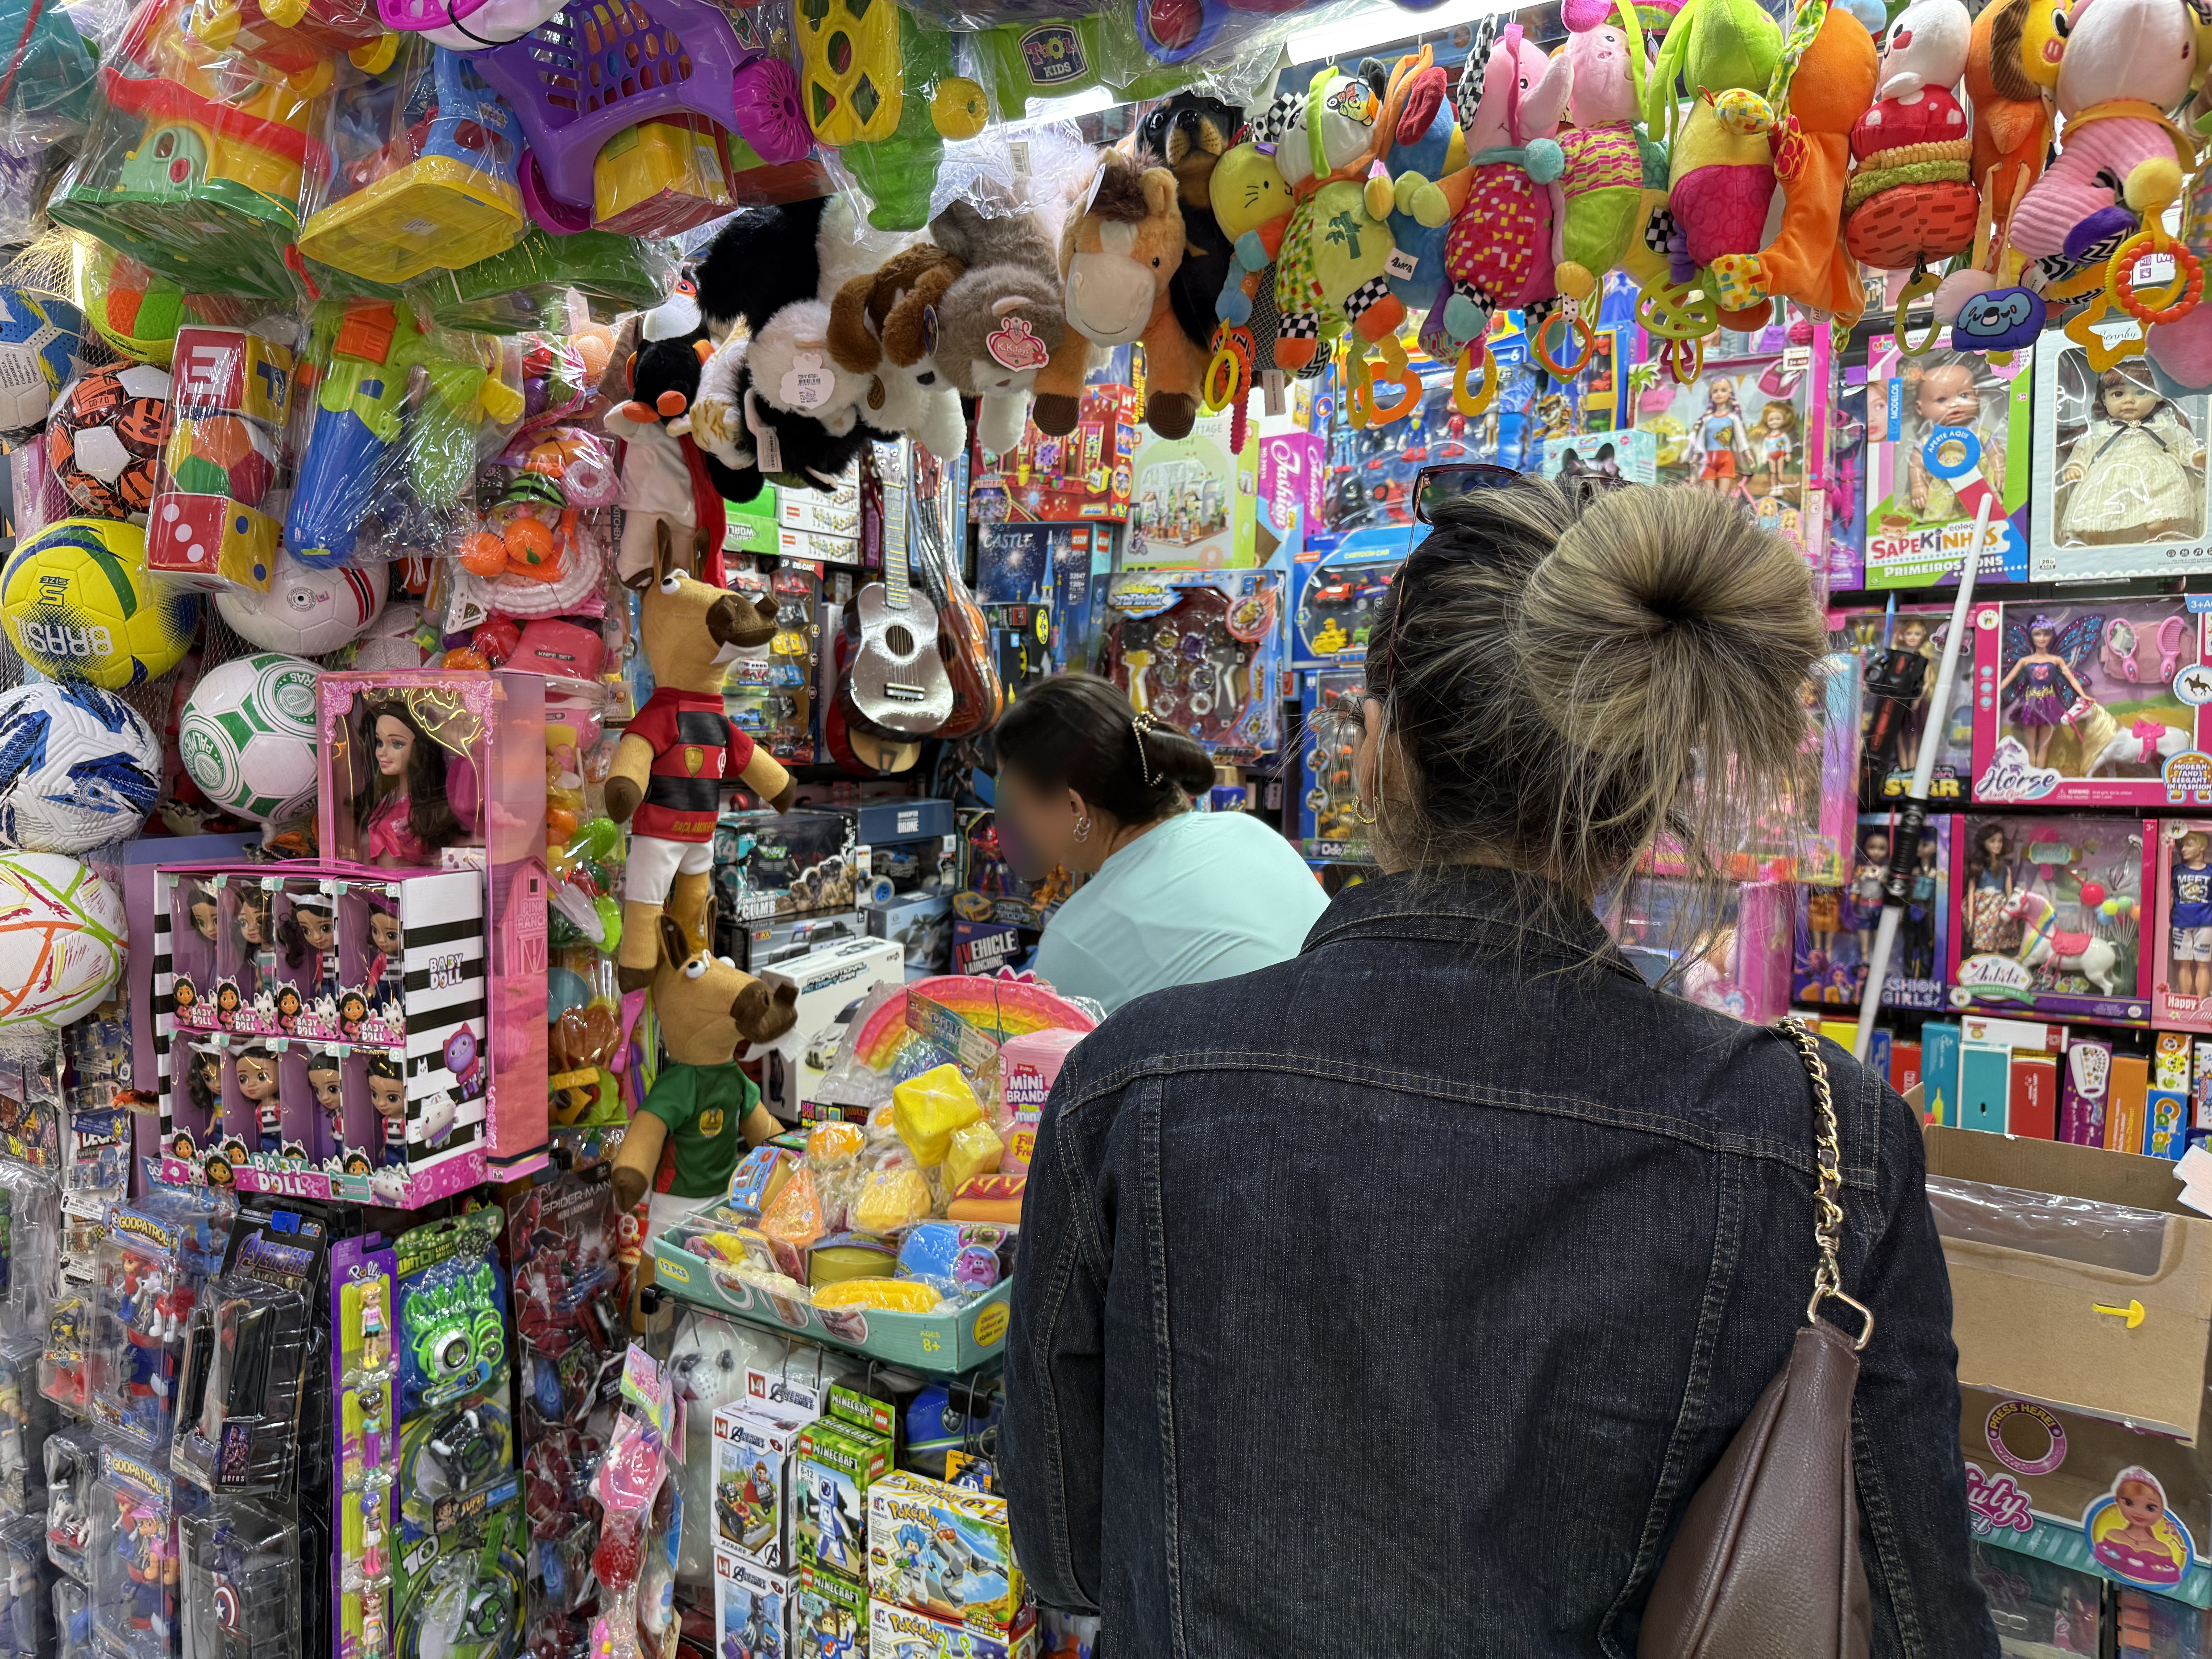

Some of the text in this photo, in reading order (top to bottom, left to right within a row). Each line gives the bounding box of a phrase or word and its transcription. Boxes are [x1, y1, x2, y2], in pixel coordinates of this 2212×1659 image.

[1024, 37, 1076, 66] TOOL
[1043, 62, 1072, 77] KIDS
[1511, 349, 1519, 361] 6
[17, 369, 26, 384] Ciudad
[1890, 384, 1899, 420] MODELOS
[1192, 424, 1223, 434] OTTAGE
[1927, 431, 1948, 453] APERTE
[1270, 440, 1302, 531] Fashion
[1306, 444, 1324, 518] Fashion
[613, 505, 622, 541] KITCHEN
[728, 524, 754, 538] WORL
[1949, 522, 1976, 532] coleç
[983, 533, 1034, 549] CASTLE
[1884, 559, 1961, 578] PRIMEIROS
[41, 576, 69, 586] SIZE
[39, 585, 68, 607] 5
[11, 614, 114, 656] BRASIL
[2173, 763, 2208, 771] MODERN
[1976, 768, 2056, 795] Horse
[897, 821, 919, 834] DRONE
[2177, 874, 2210, 885] MEET
[522, 898, 545, 915] PINK
[956, 930, 1018, 963] VEHICLE
[429, 953, 464, 973] BABY
[963, 955, 1004, 975] LAUNCHING
[430, 968, 464, 990] DOLL
[807, 962, 867, 984] PROPORTIONAL
[839, 972, 857, 984] CAR
[1881, 990, 1934, 1007] GIRLS
[2167, 994, 2197, 1011] Happy
[192, 1007, 211, 1017] BABY
[192, 1015, 213, 1026] DOLL
[235, 1012, 256, 1022] BABY
[297, 1017, 318, 1026] BABY
[235, 1020, 256, 1031] DOLL
[297, 1025, 318, 1037] DOLL
[361, 1022, 385, 1032] BABY
[362, 1031, 385, 1042] DOLL
[254, 1155, 302, 1175] BABY
[258, 1172, 306, 1195] DOLL
[542, 1178, 612, 1216] SPIDER-MAN
[557, 1198, 594, 1221] HERO LAUNCHER
[118, 1214, 169, 1247] GODPATROL
[234, 1228, 315, 1277] AVENGERS
[435, 1241, 454, 1254] LIGHT
[435, 1247, 457, 1259] MUSIC
[349, 1259, 383, 1280] Polly
[659, 1262, 687, 1279] 12 PCS
[923, 1338, 941, 1352] 8+
[831, 1393, 874, 1417] MINECRAFT
[1989, 1403, 2057, 1430] PRESS HERE!
[821, 1418, 880, 1443] MINECRAFT
[813, 1443, 859, 1470] MINECRAFT
[112, 1457, 161, 1494] GODPATROL
[814, 1575, 860, 1604] MINECRAFT
